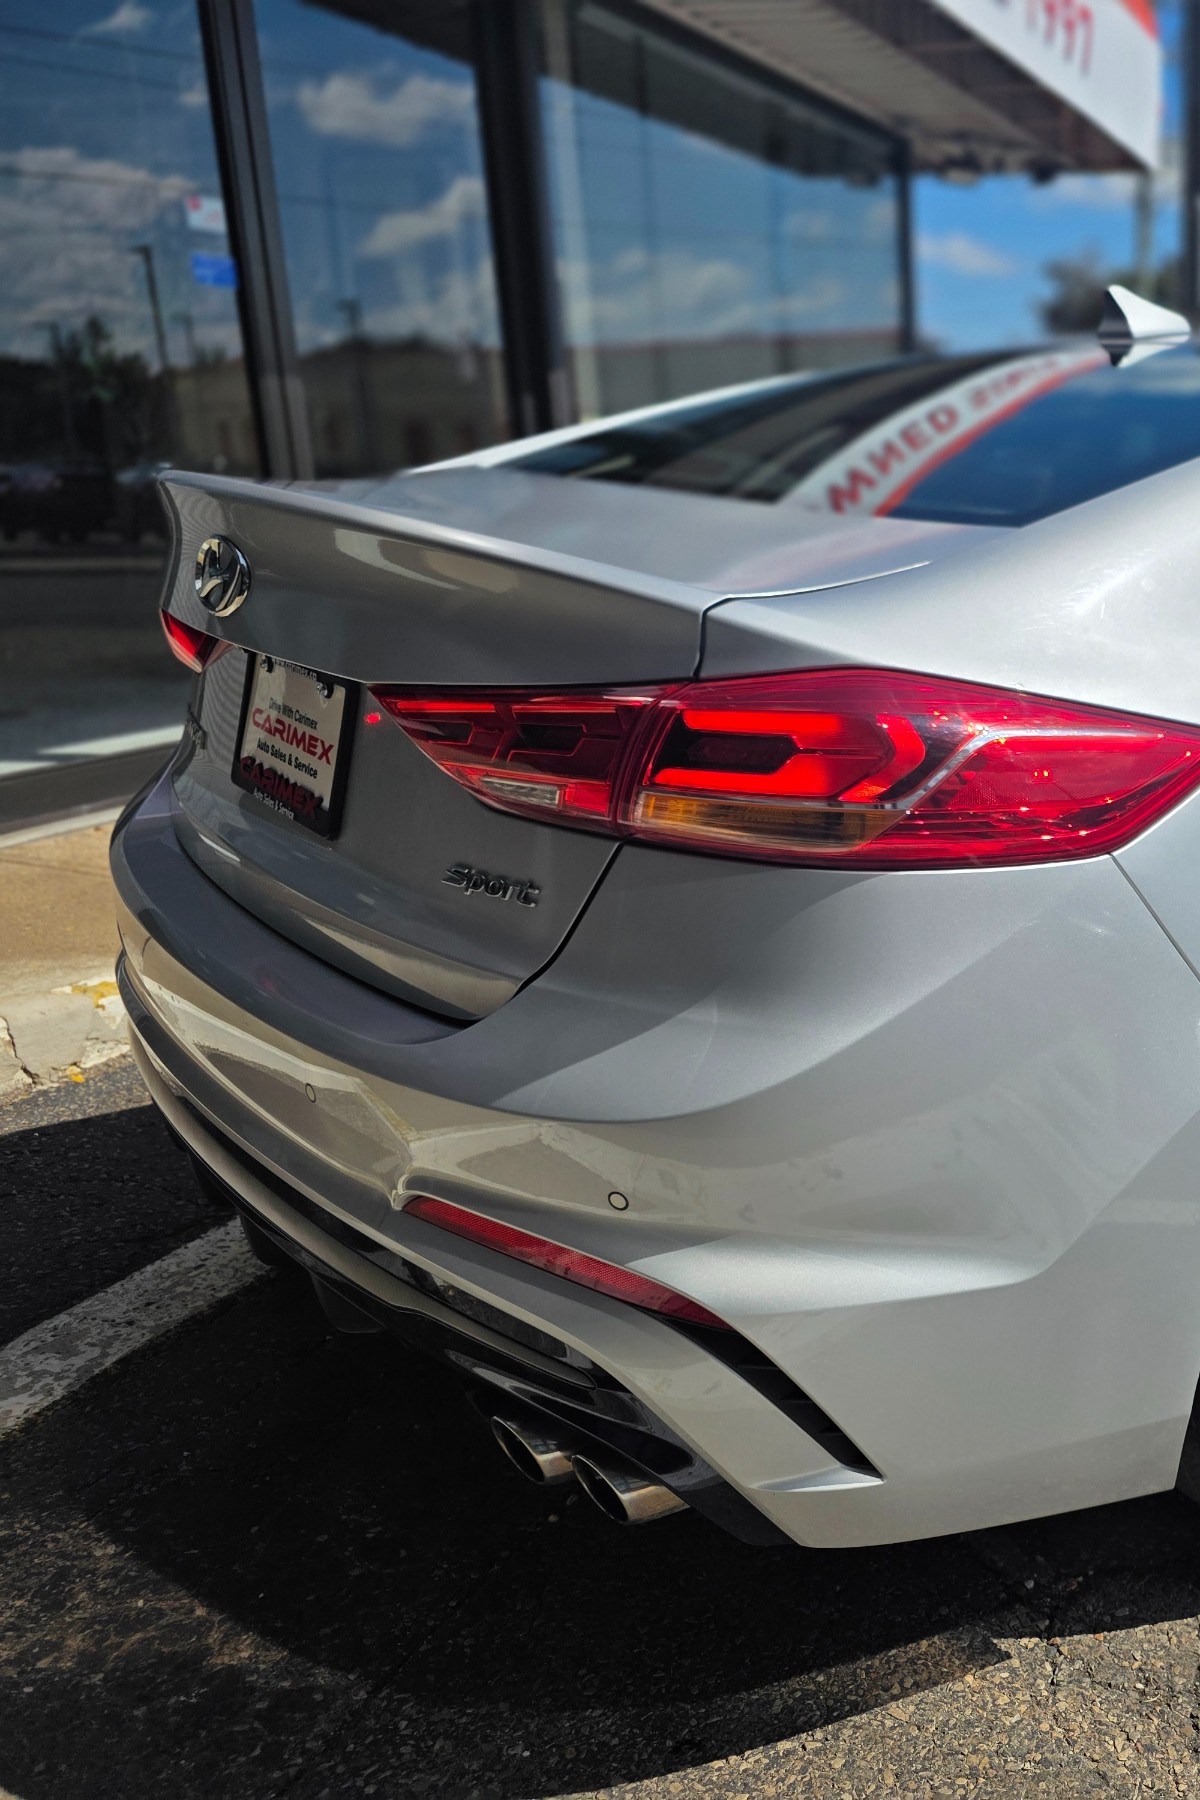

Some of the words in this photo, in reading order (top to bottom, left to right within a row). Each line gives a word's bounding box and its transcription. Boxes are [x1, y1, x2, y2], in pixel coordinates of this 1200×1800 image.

[251, 707, 336, 766] CARIMEX
[268, 697, 281, 715] Drive
[281, 702, 294, 720] With
[294, 708, 319, 731] Carimex
[256, 738, 270, 754] Auto
[270, 743, 287, 764] Sales
[287, 752, 293, 767] &
[293, 756, 319, 780] Service
[239, 755, 324, 819] CARIMEX
[440, 861, 542, 908] Sport
